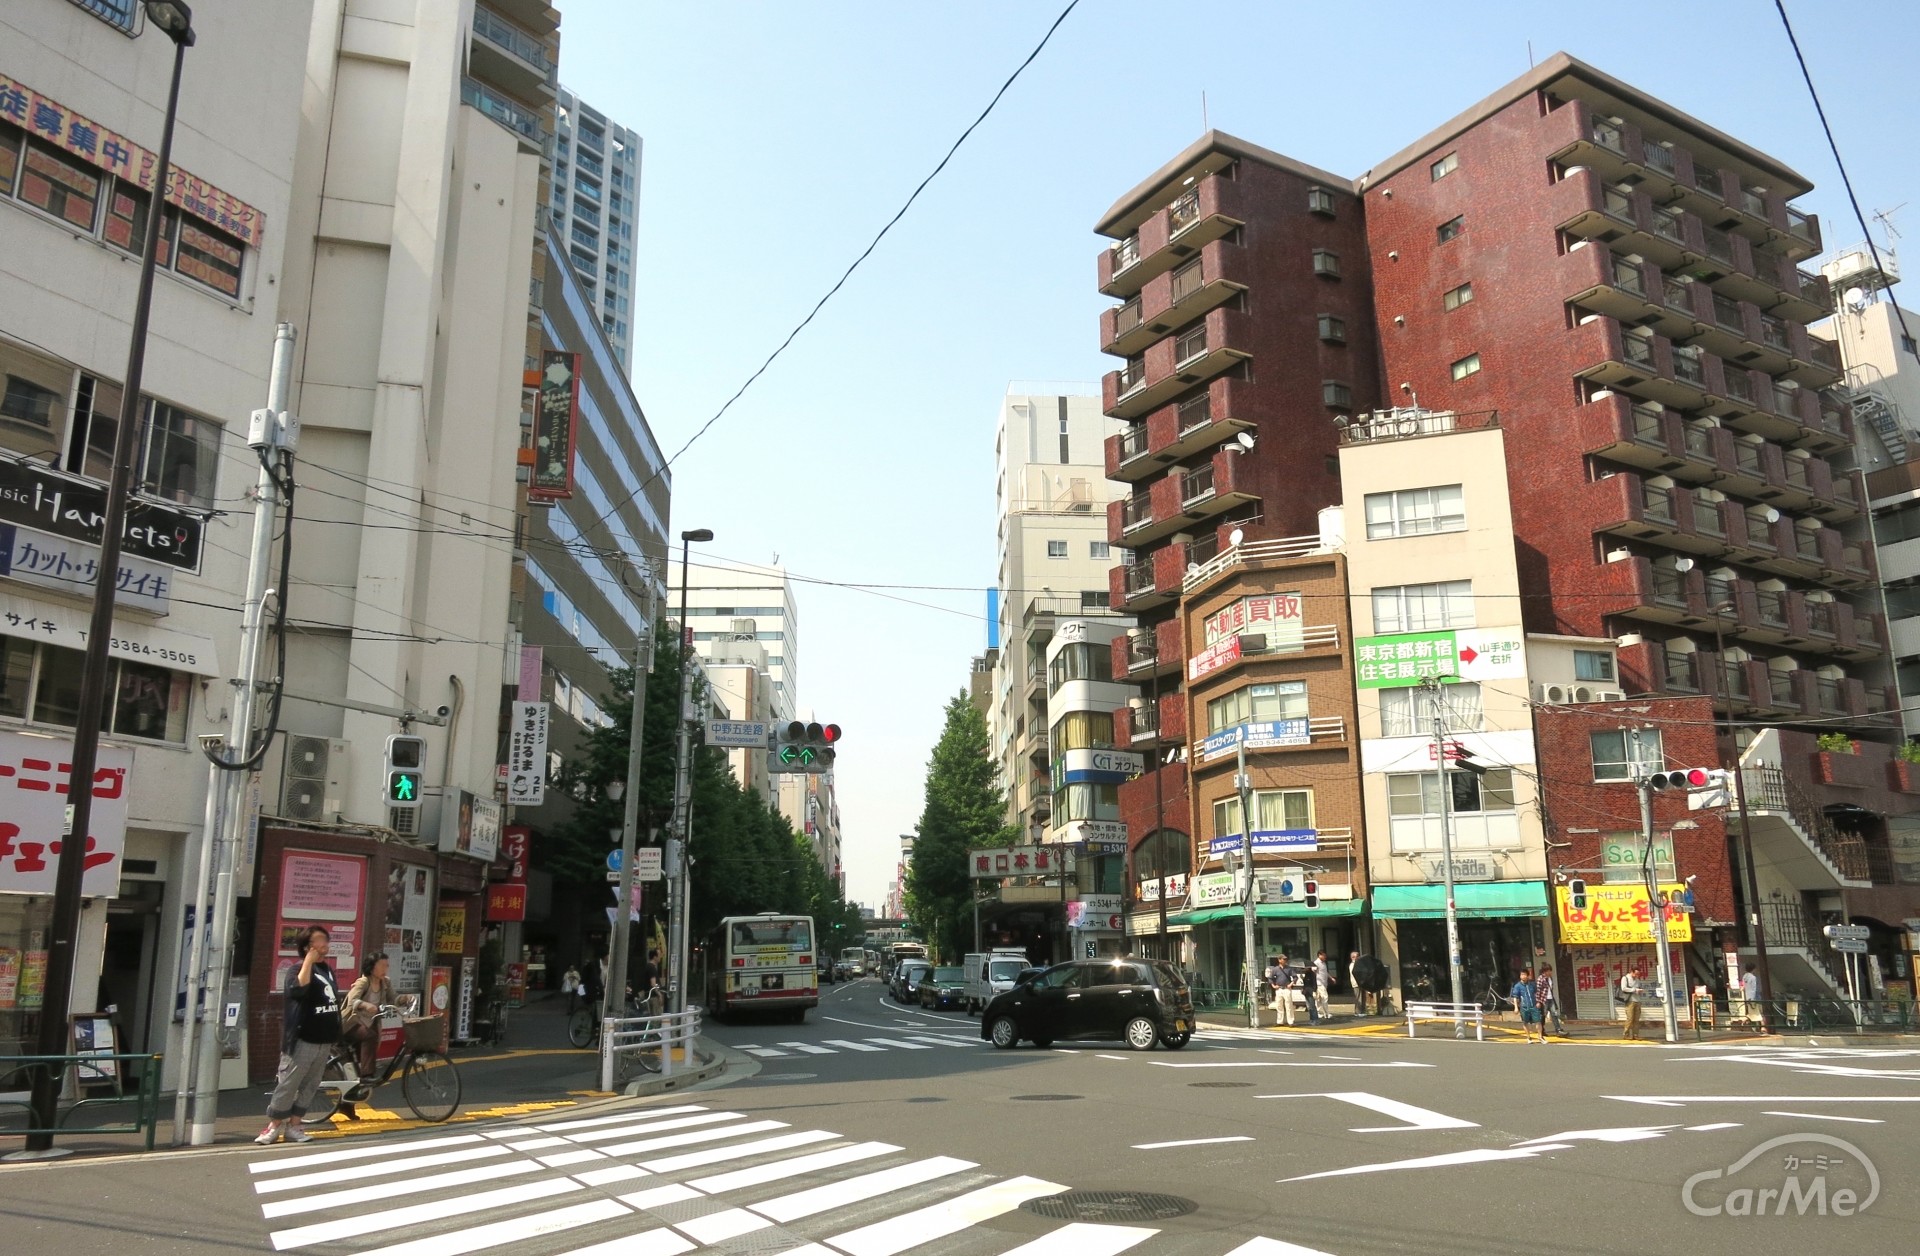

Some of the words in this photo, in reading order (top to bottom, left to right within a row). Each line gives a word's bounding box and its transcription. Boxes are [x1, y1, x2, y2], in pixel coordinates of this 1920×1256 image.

[0, 487, 29, 504] sic
[5, 611, 58, 634] サイキ
[1207, 595, 1300, 641] 不動産買取
[110, 638, 197, 665] 3384-3505
[1358, 639, 1453, 662] 東京都新宿
[1479, 640, 1521, 653] 山手通り
[1359, 659, 1455, 681] 住宅展示場
[1490, 655, 1512, 665] 右折
[537, 706, 546, 744] ジンギスカン
[711, 723, 764, 736] 中野五差路
[521, 706, 537, 772] ゆきだるま
[715, 735, 759, 743] Nakanogosaro
[512, 732, 521, 772] 中野部屋本店
[491, 896, 522, 908] 謝謝
[315, 1004, 339, 1014] PLAY
